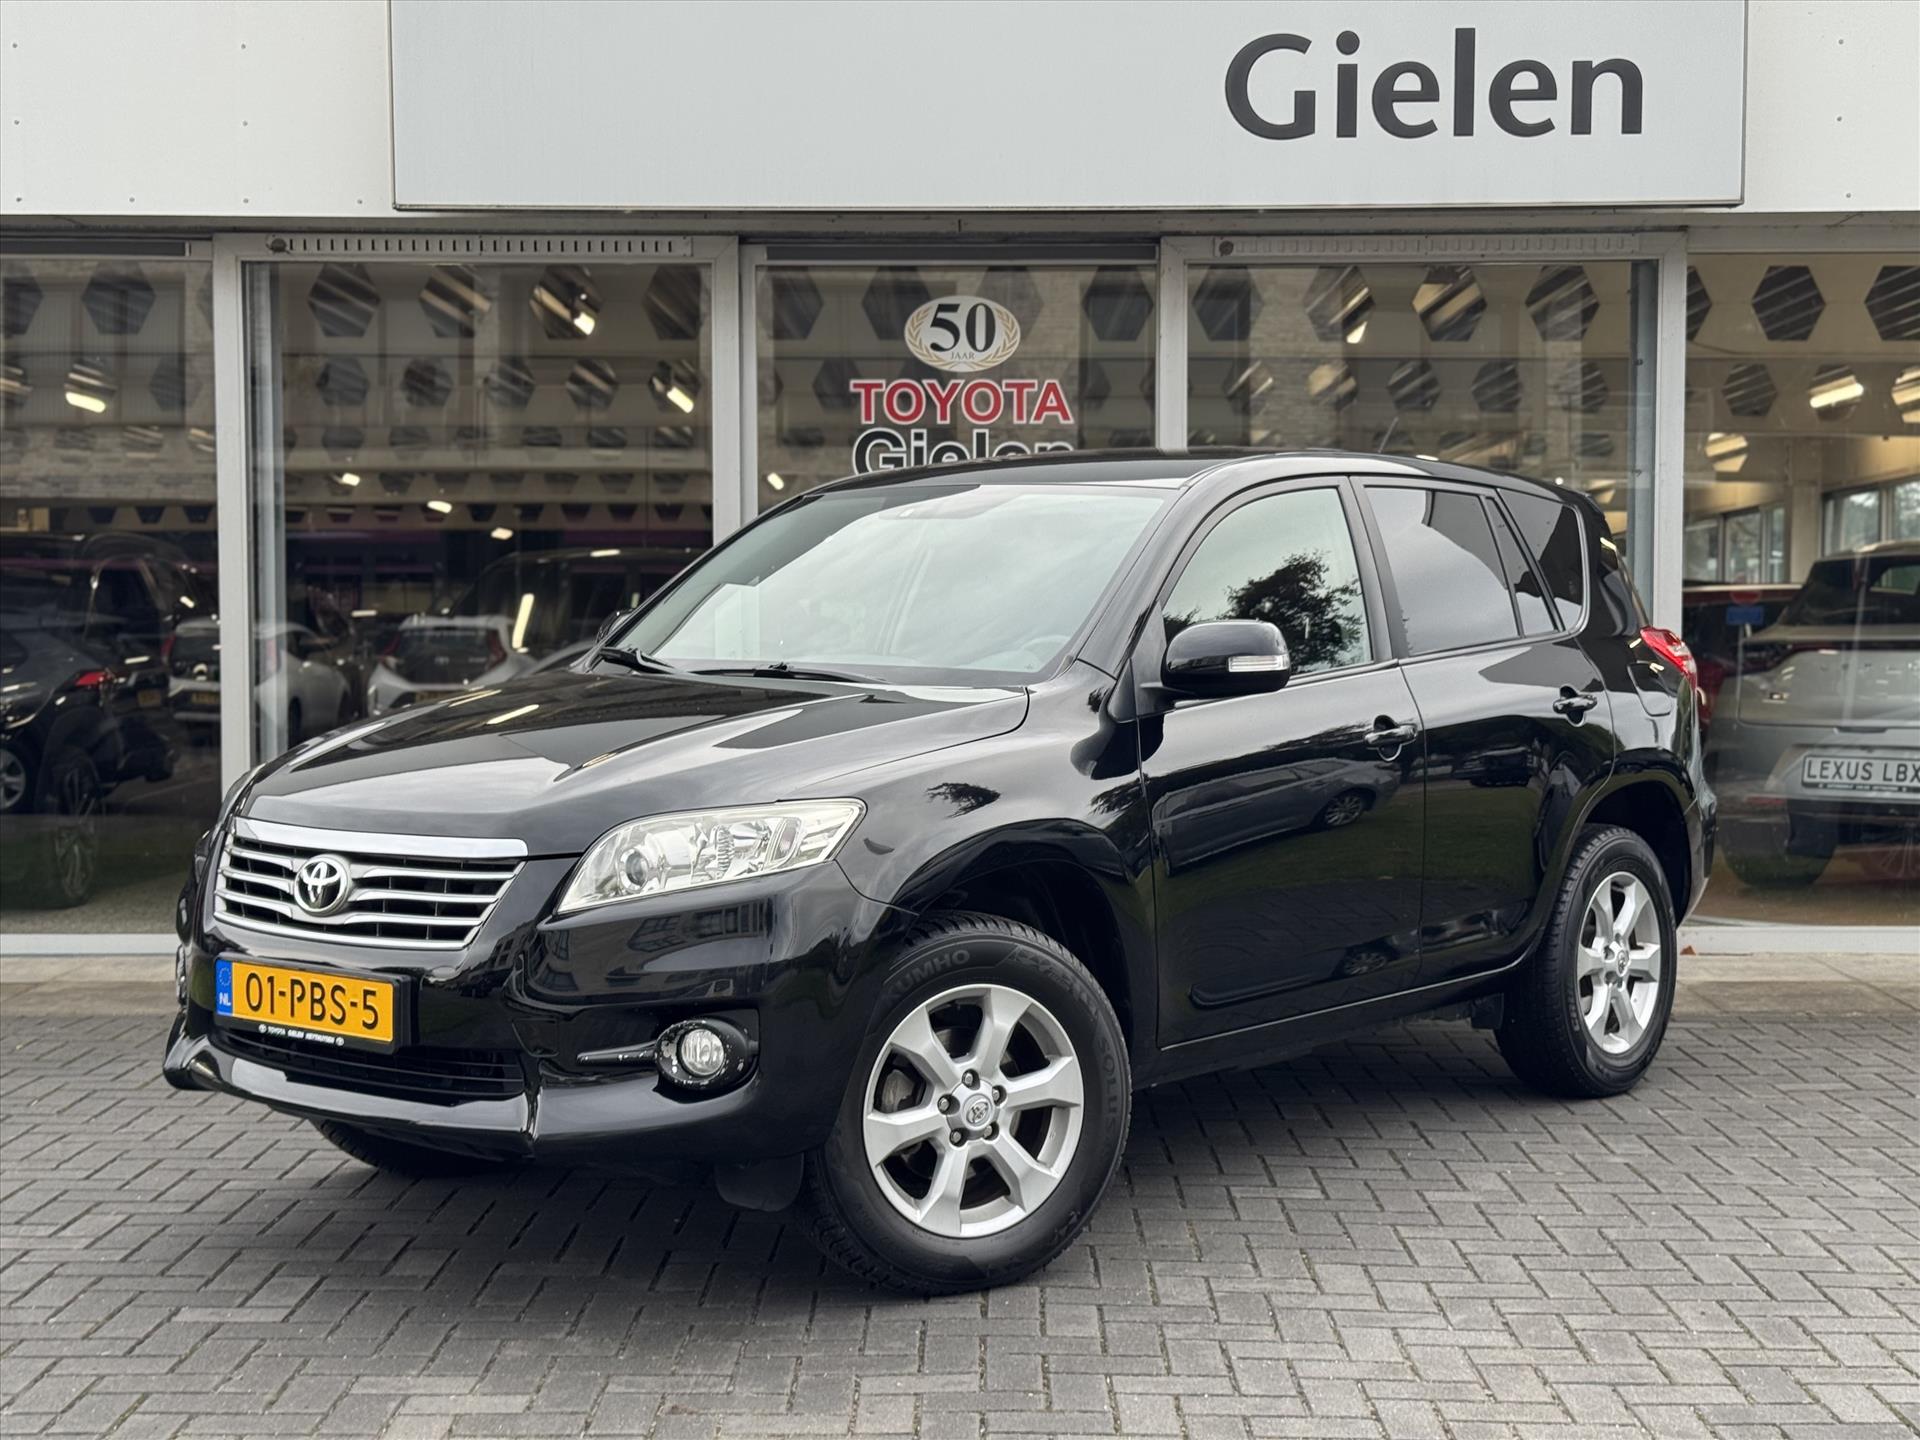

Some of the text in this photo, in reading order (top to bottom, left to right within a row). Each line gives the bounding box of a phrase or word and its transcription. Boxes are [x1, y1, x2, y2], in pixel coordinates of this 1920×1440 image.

[1225, 27, 1643, 140] Gielen
[930, 302, 996, 353] 50
[950, 351, 976, 360] JAAR
[850, 379, 1075, 425] TOYOTA
[1807, 759, 1920, 784] LEXUS LBX
[218, 992, 232, 1007] NL
[245, 972, 379, 1031] 01-PBS-5
